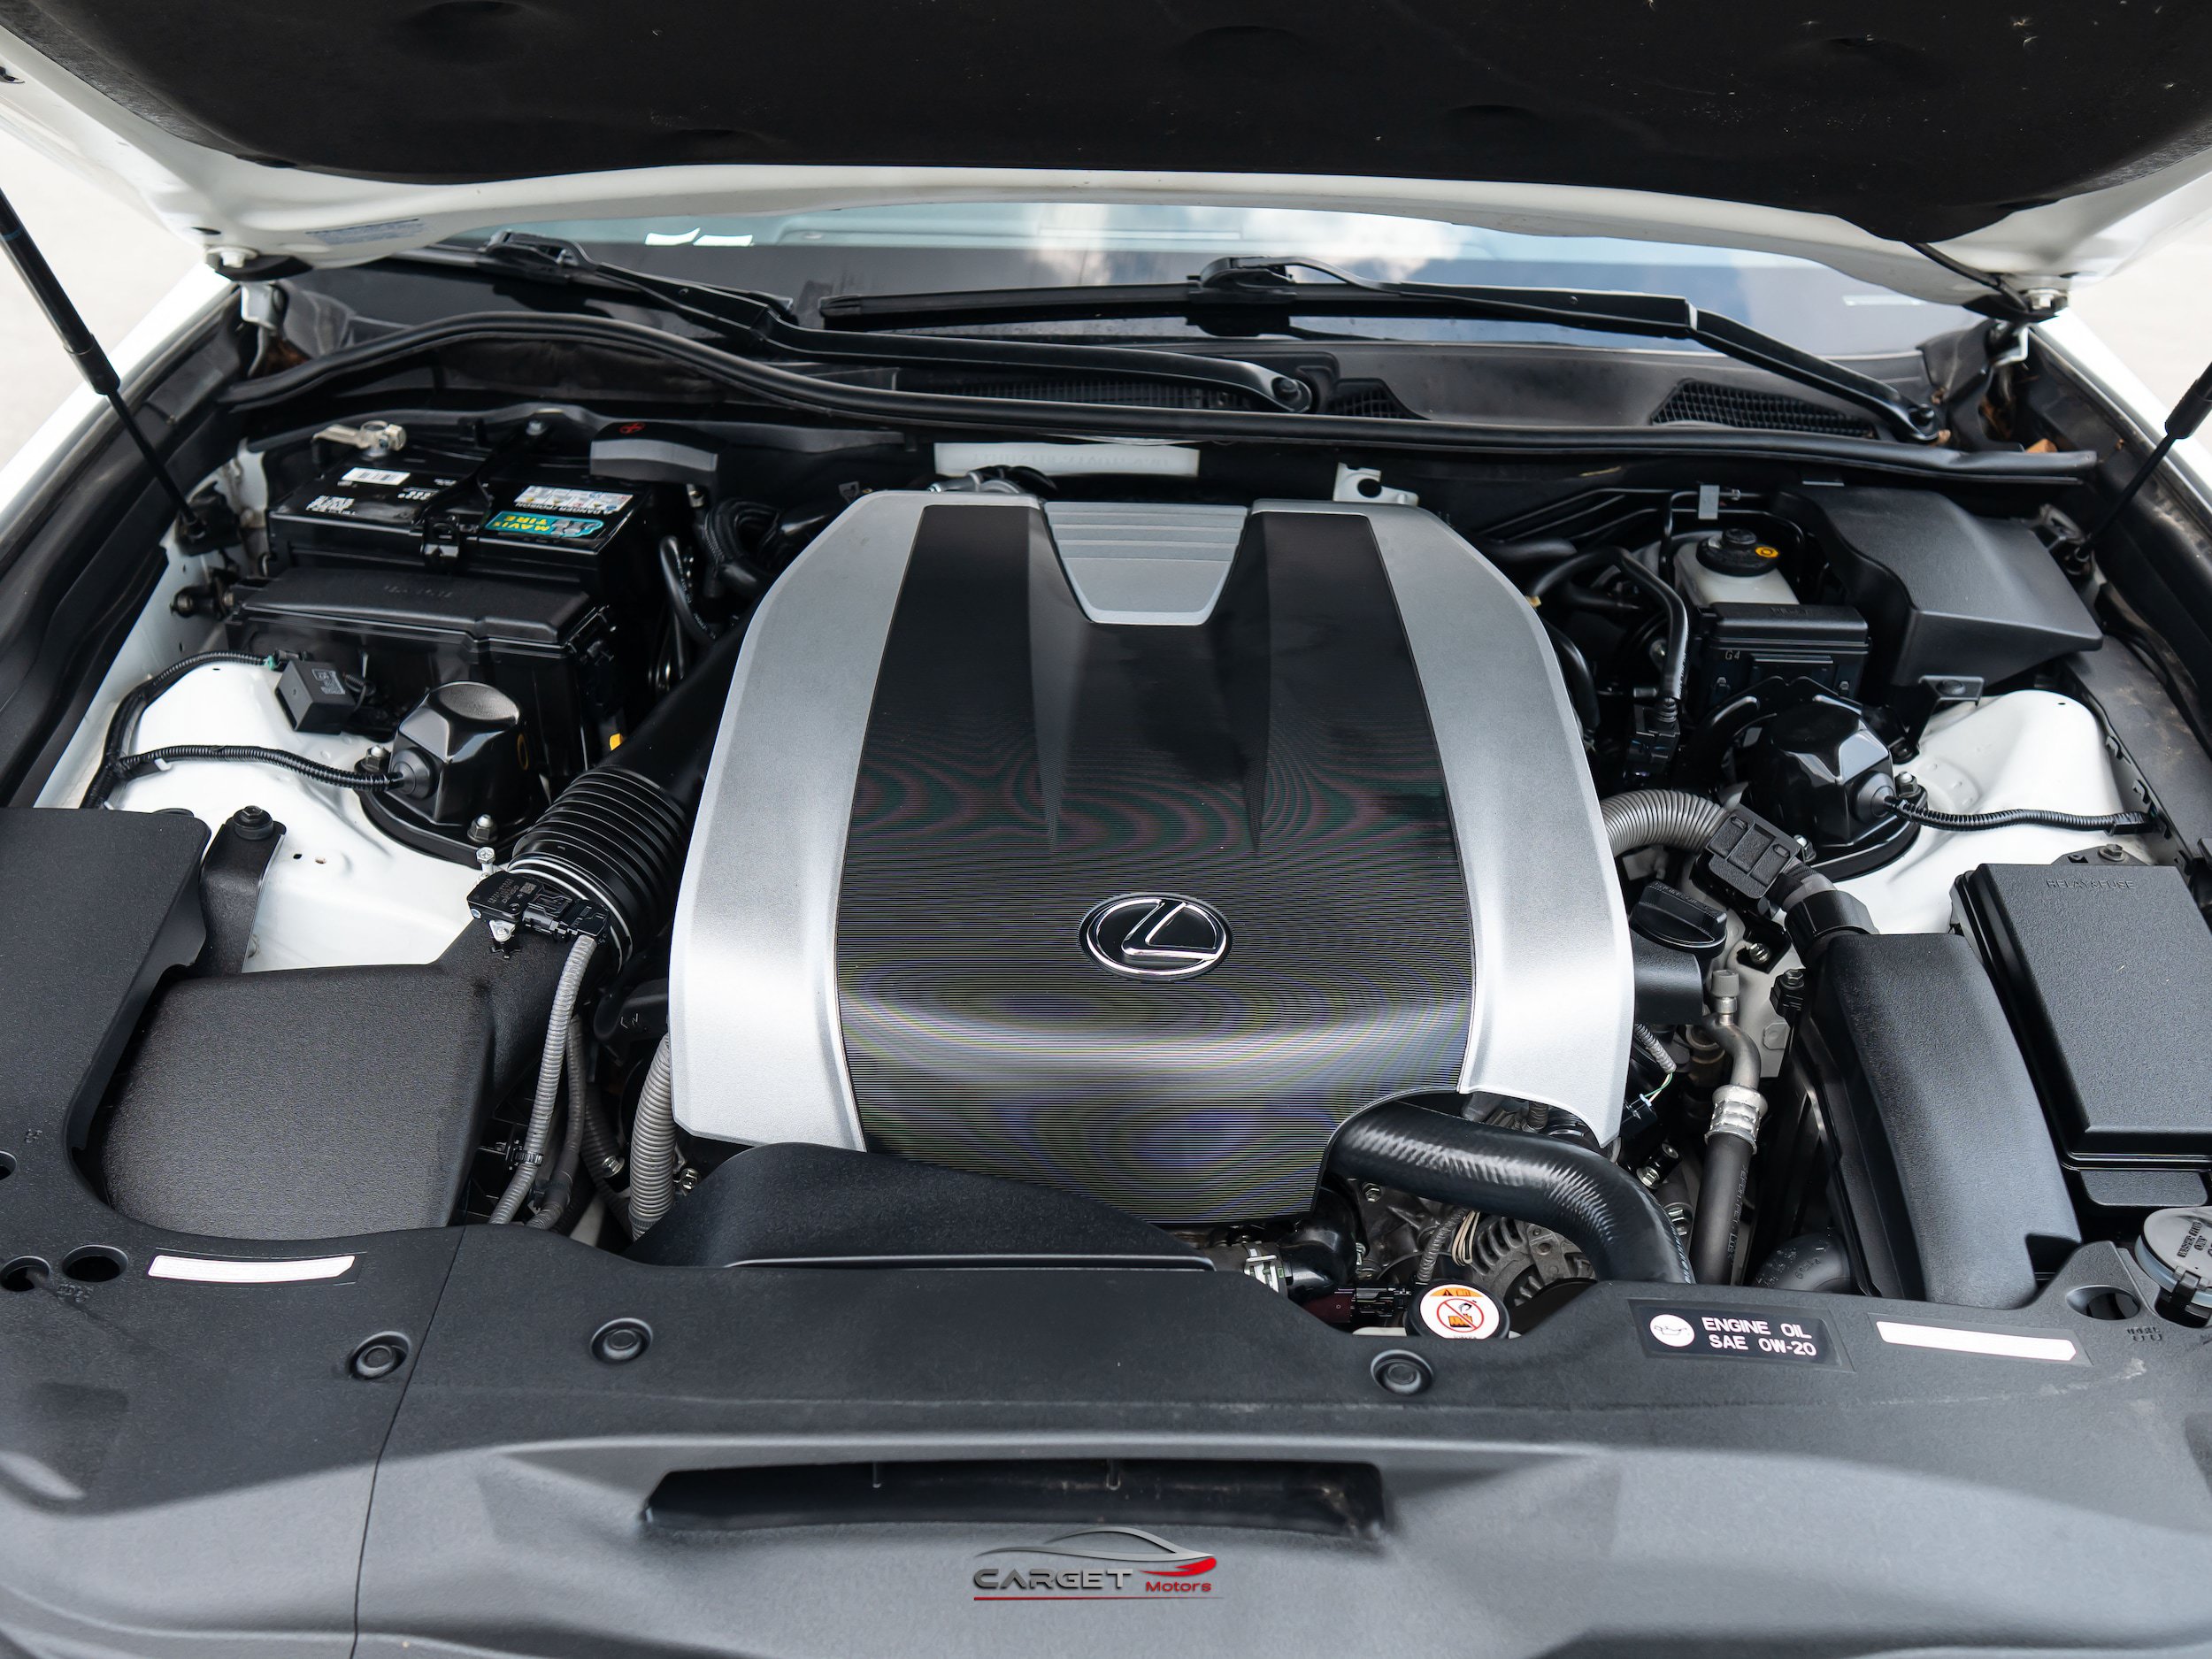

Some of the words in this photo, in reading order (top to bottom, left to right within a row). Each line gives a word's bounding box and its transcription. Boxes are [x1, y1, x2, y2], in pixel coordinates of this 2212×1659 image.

[503, 516, 548, 526] TIRE
[1701, 1317, 1771, 1335] ENGINE
[1780, 1323, 1812, 1340] OIL
[1708, 1334, 1749, 1350] SAE
[1758, 1338, 1817, 1356] 0W-20
